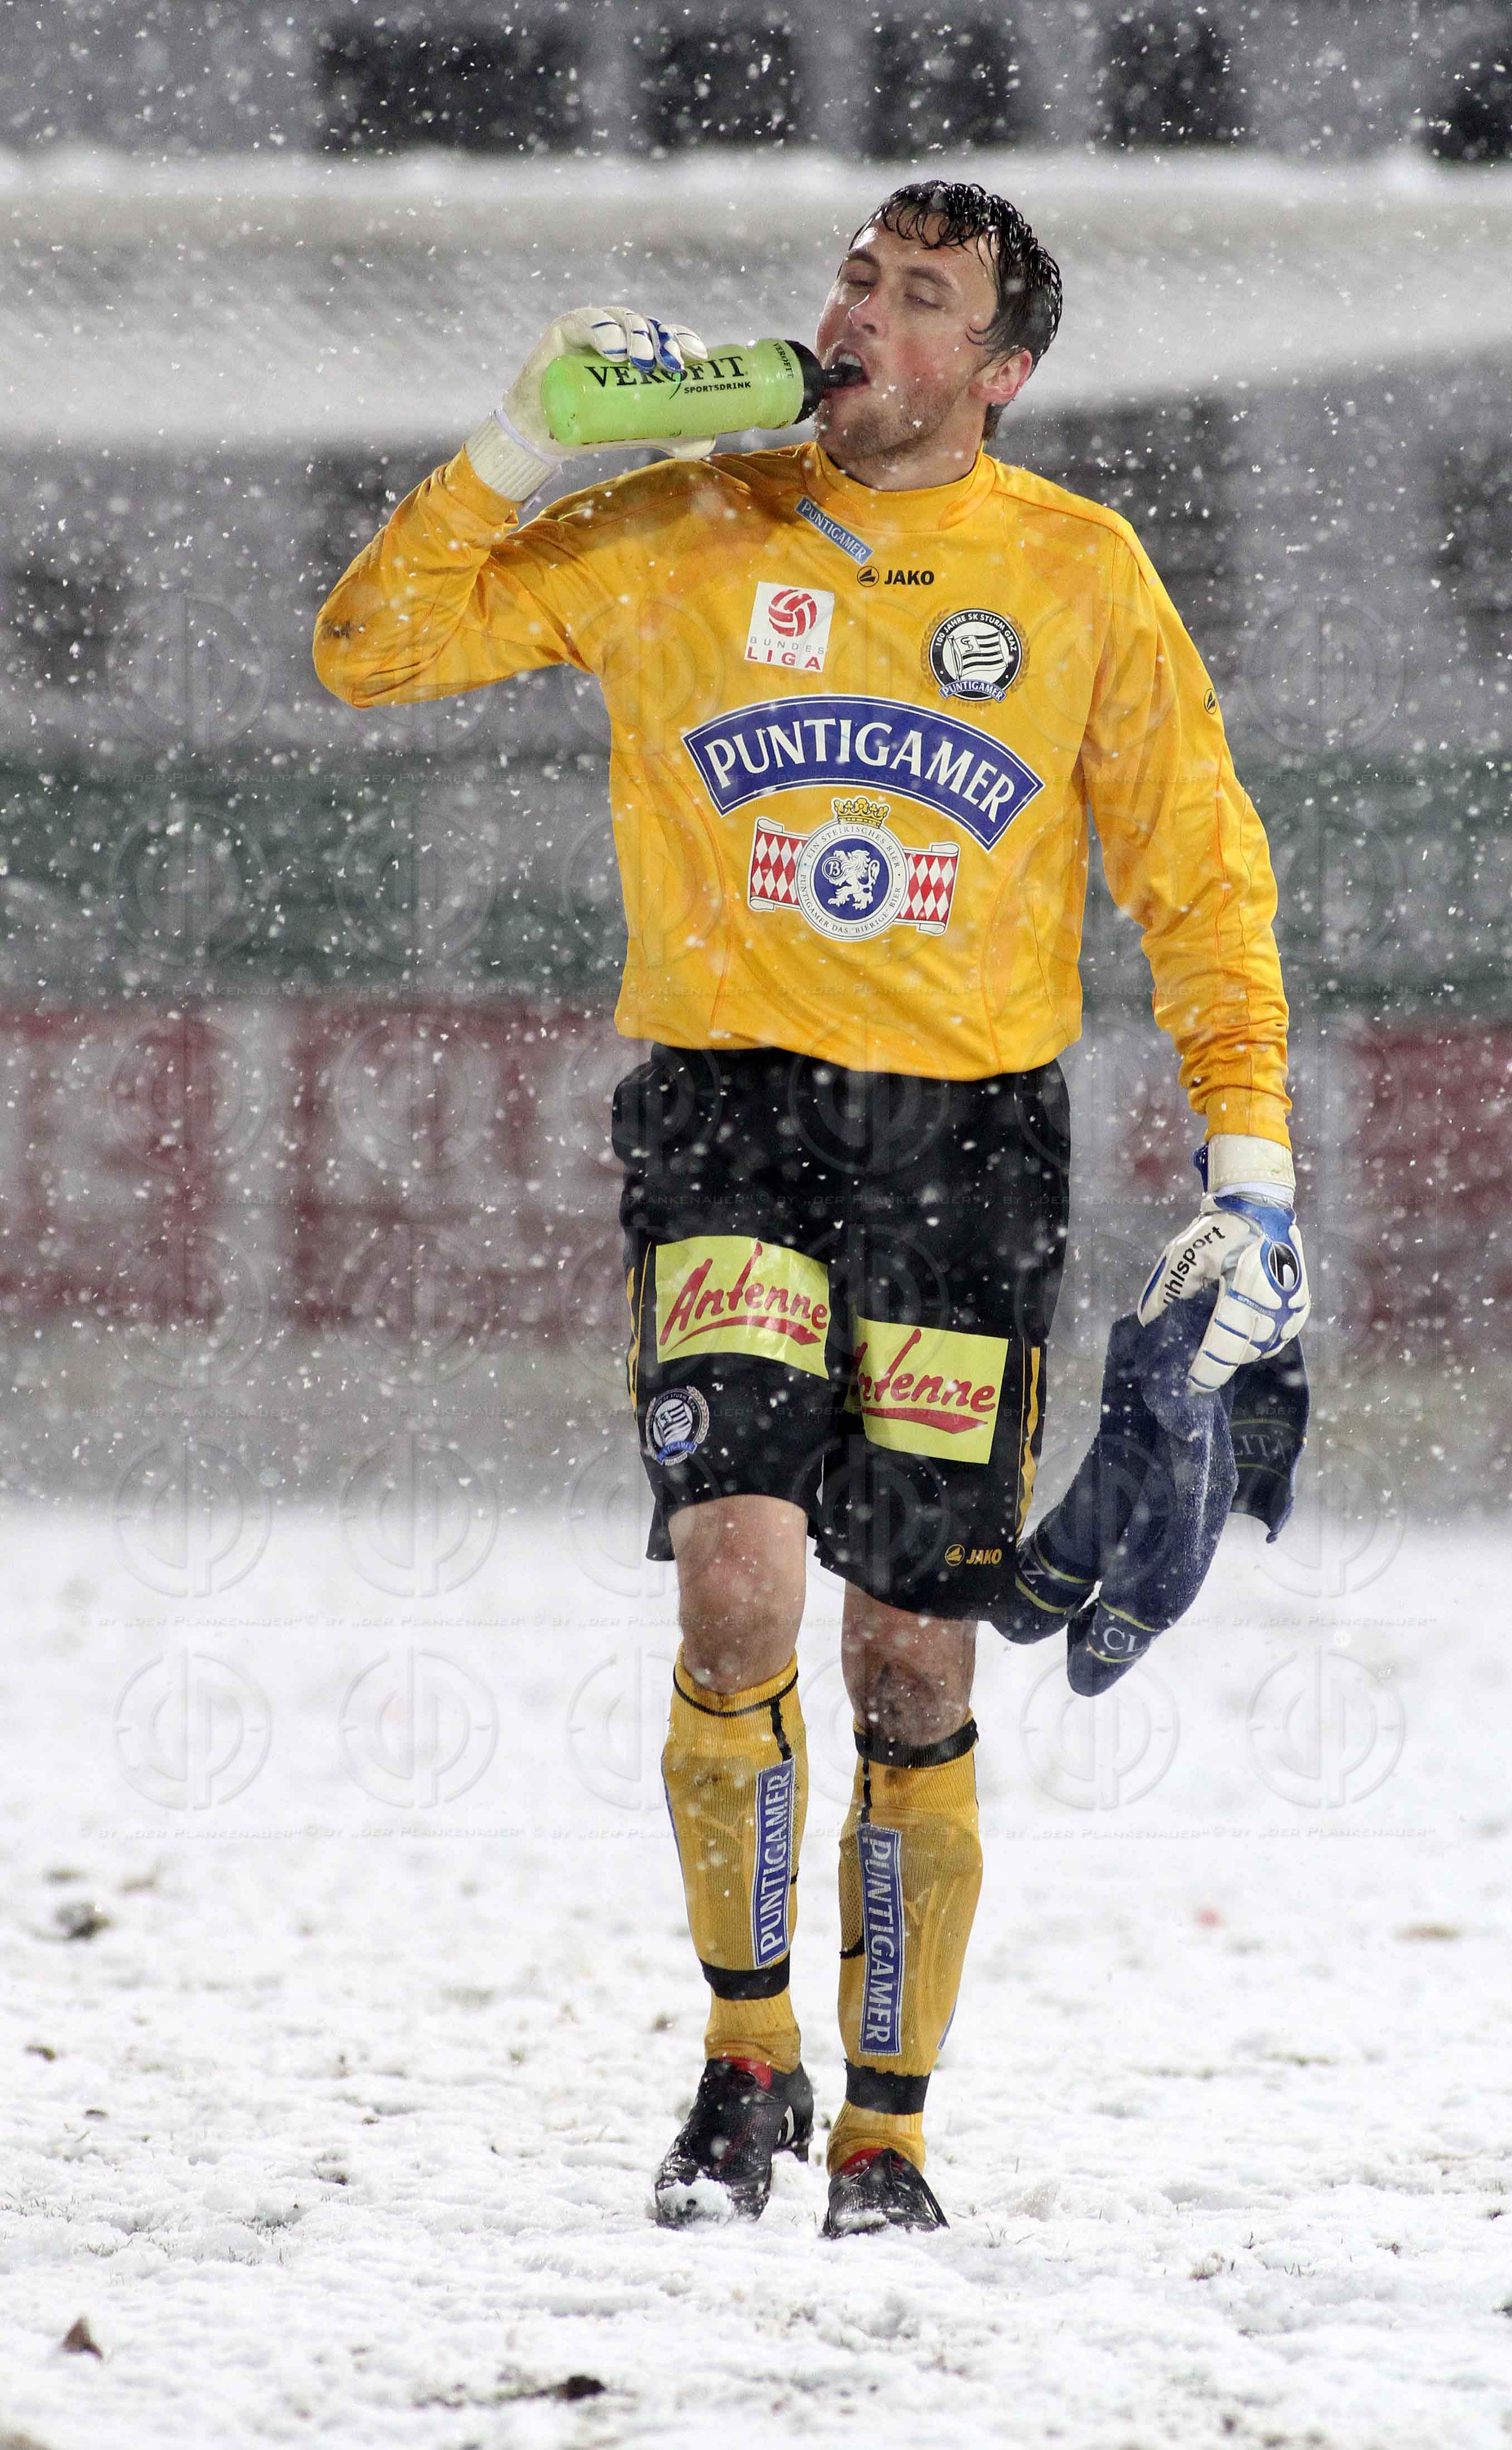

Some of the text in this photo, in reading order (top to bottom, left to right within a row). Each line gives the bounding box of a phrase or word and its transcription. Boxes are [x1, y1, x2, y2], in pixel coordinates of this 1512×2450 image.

[684, 381, 751, 393] SPORTSDRINK
[801, 500, 867, 559] PUNTIGAMER
[884, 569, 935, 586] JAKO
[749, 636, 825, 655] BUNDES
[935, 633, 946, 647] 100
[944, 614, 966, 634] JAHRE
[980, 613, 1006, 631] STURM
[1003, 630, 1017, 652] GRAZ
[747, 646, 821, 670] LIGA
[942, 680, 1003, 701] PUNTIGAMER
[704, 718, 1016, 824] PUNTIGAMER
[806, 826, 900, 868] EIN STEIRISCHES BIER
[800, 874, 830, 928] PUNTIGAMER
[831, 923, 849, 934] DAS
[890, 887, 902, 909] BIER
[1163, 1225, 1226, 1305] uhlsport
[660, 1240, 828, 1346] Antenne
[965, 1547, 1002, 1566] JAKO
[760, 1771, 791, 1957] PUNTIGAMER
[863, 1837, 892, 2043] PUNTIGAMER
